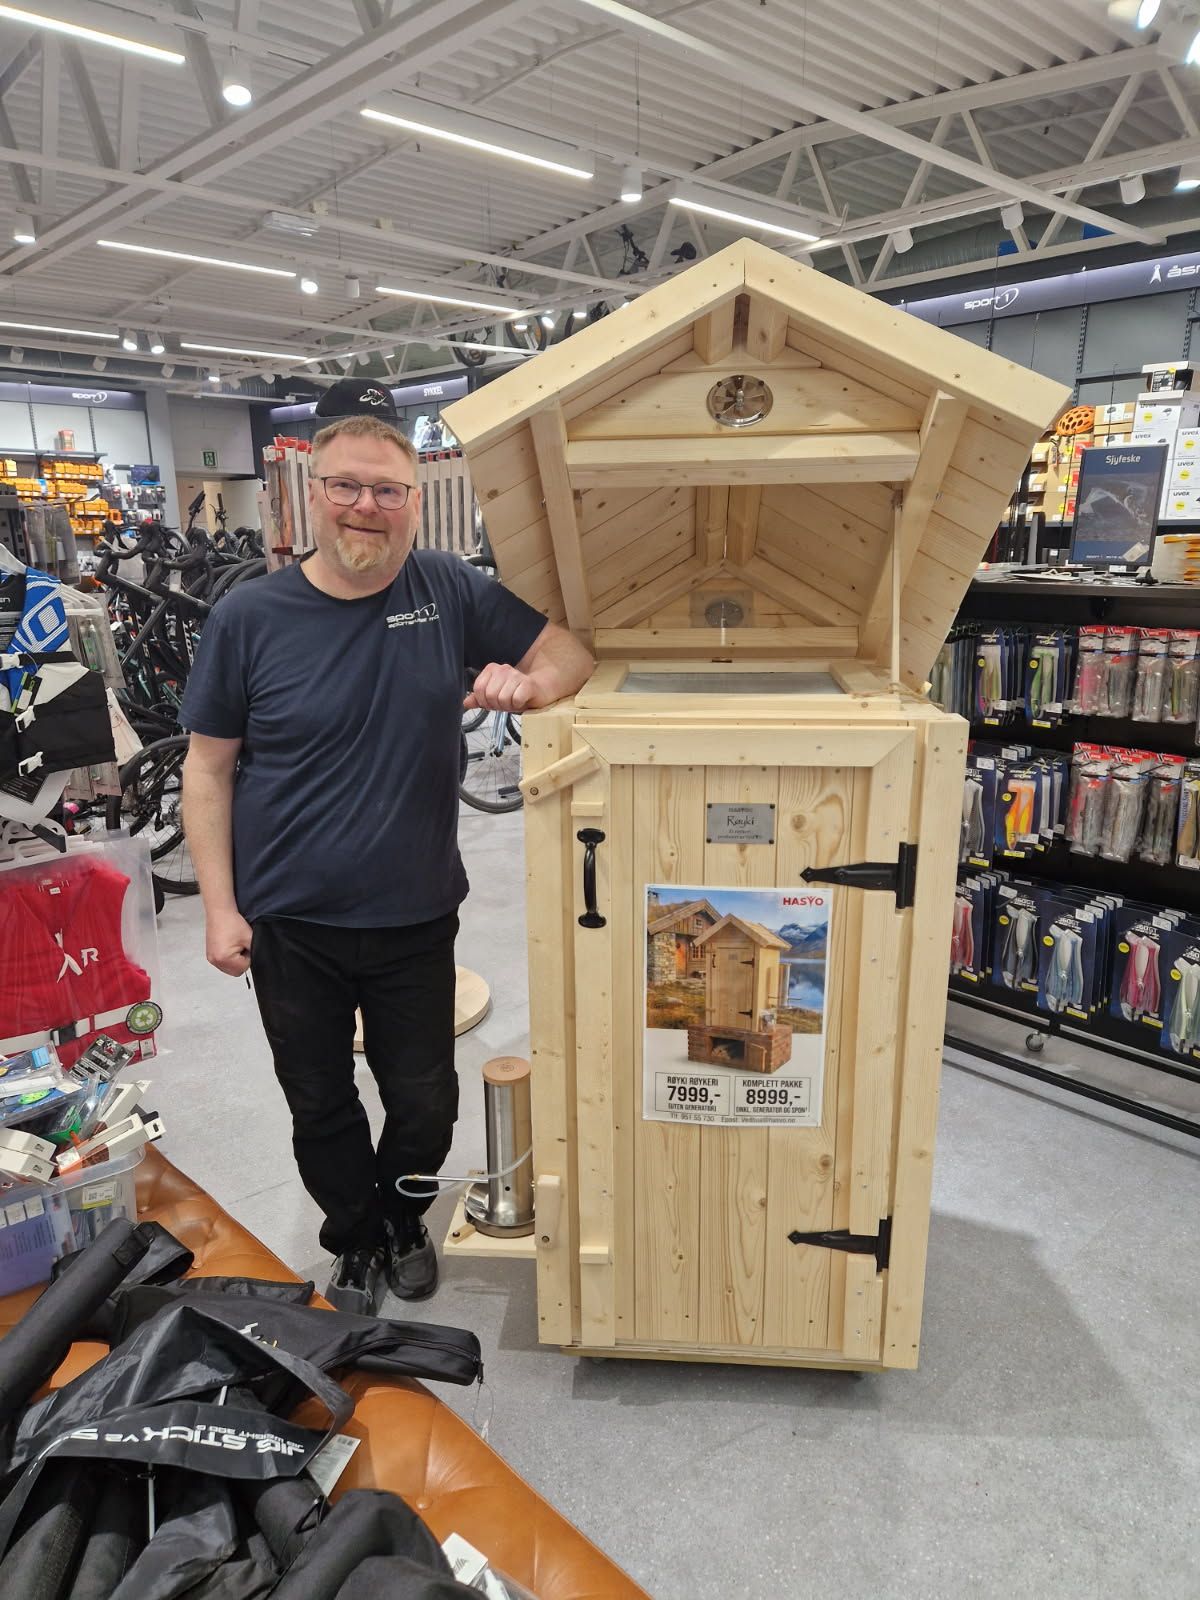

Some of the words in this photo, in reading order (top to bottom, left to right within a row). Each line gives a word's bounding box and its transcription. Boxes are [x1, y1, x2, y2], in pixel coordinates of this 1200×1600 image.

[423, 386, 444, 397] SYKKEL
[1105, 454, 1141, 466] Sjyfeske
[782, 895, 824, 907] HASYO
[667, 1076, 688, 1085] RØYKI
[689, 1077, 719, 1087] RØYKERI
[742, 1079, 779, 1088] KOMPLETT
[780, 1080, 804, 1089] PAKKE
[667, 1085, 721, 1105] 7999,-
[746, 1089, 801, 1107] 8999,-
[104, 1432, 140, 1443] V2
[142, 1425, 248, 1451] STICK
[255, 1438, 305, 1457] JIG
